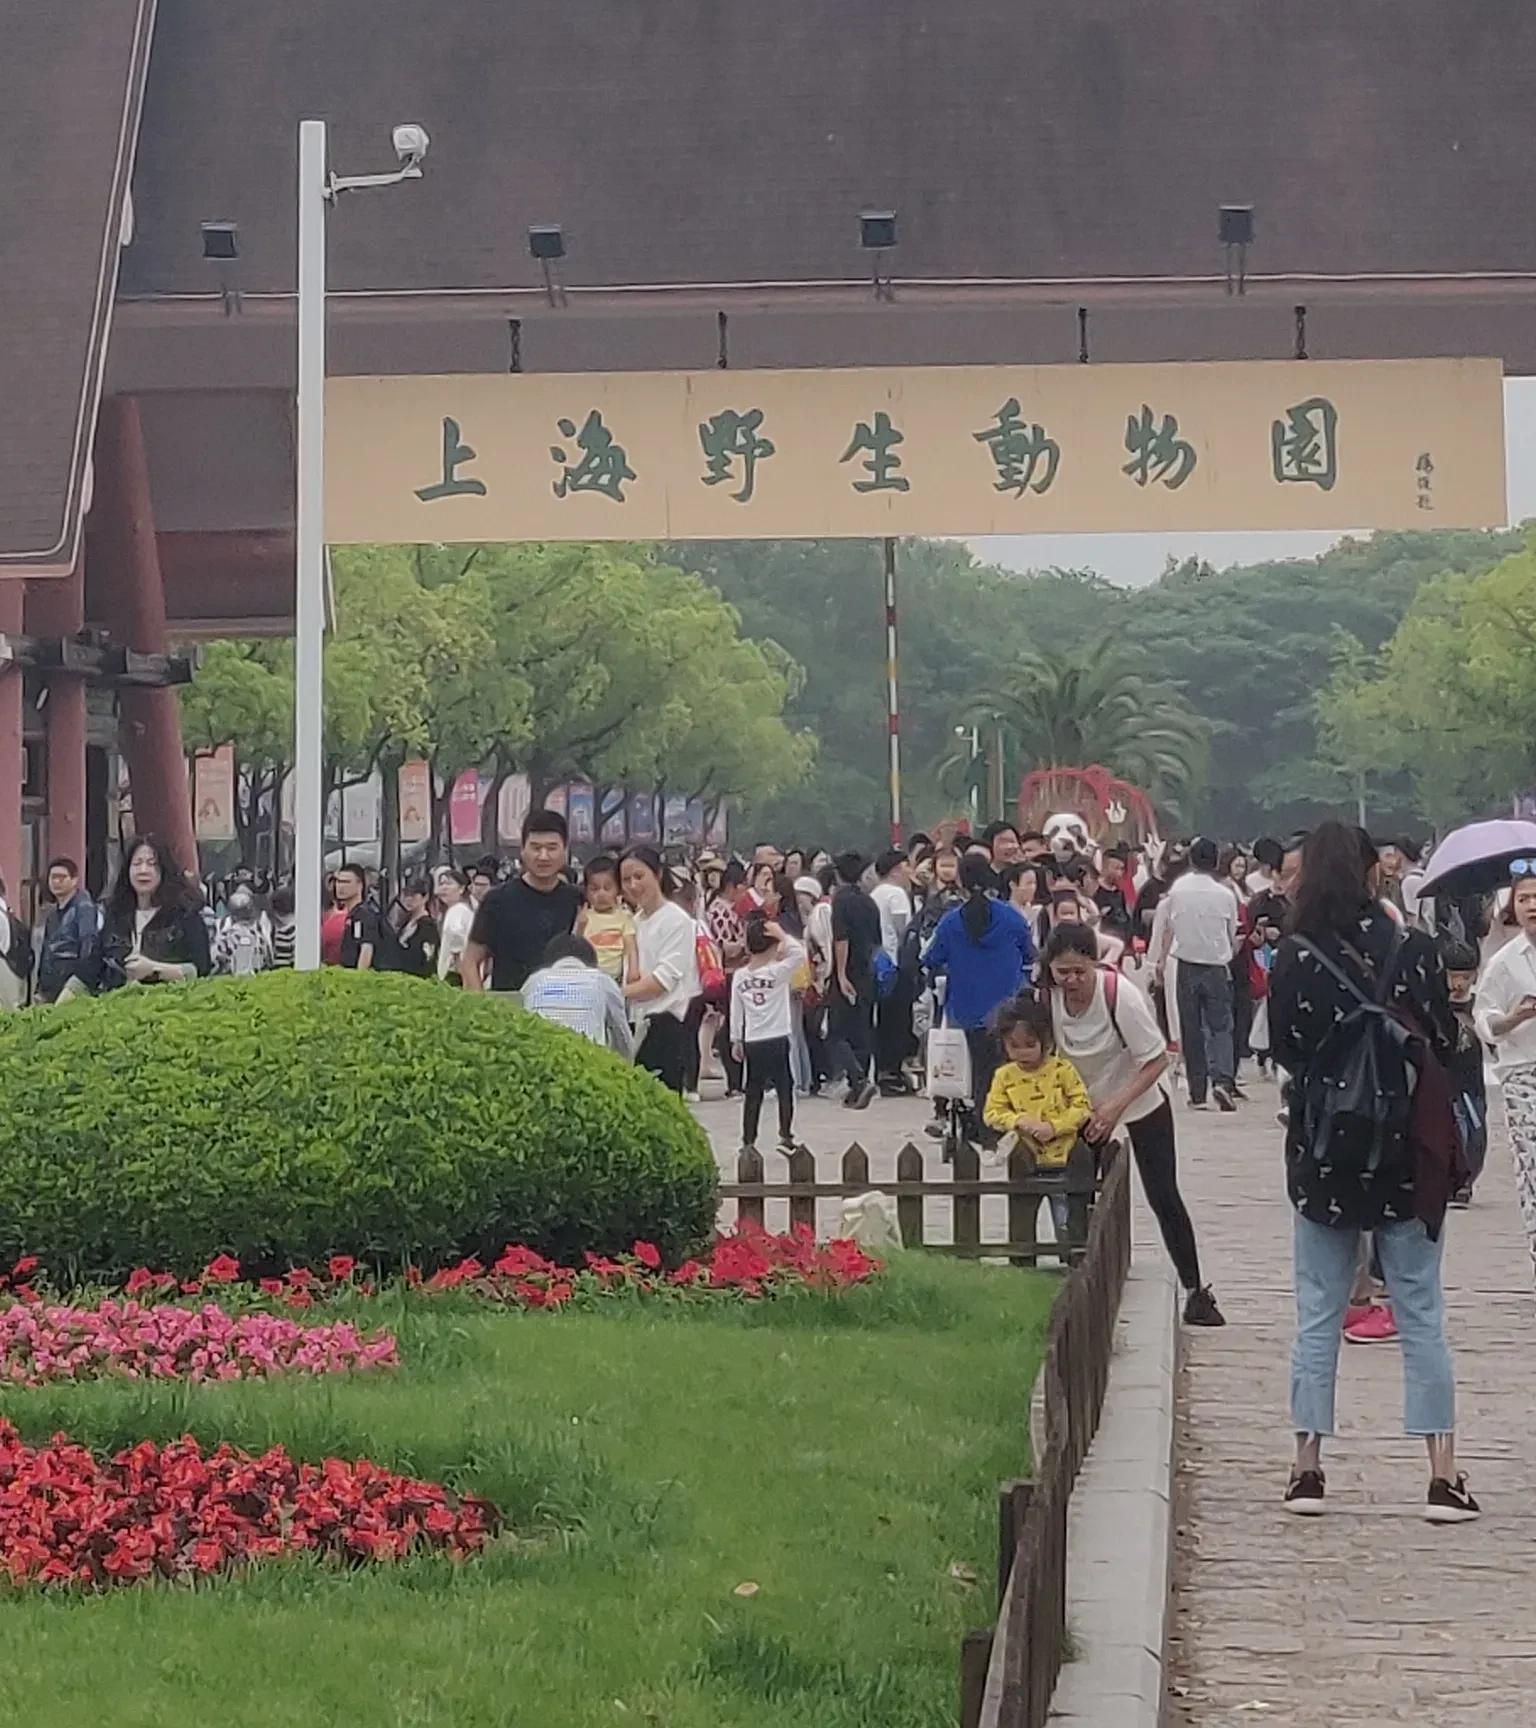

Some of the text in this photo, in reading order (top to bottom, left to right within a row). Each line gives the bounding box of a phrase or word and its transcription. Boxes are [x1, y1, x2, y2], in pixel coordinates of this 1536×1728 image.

[414, 397, 1339, 502] 上海野生動物園
